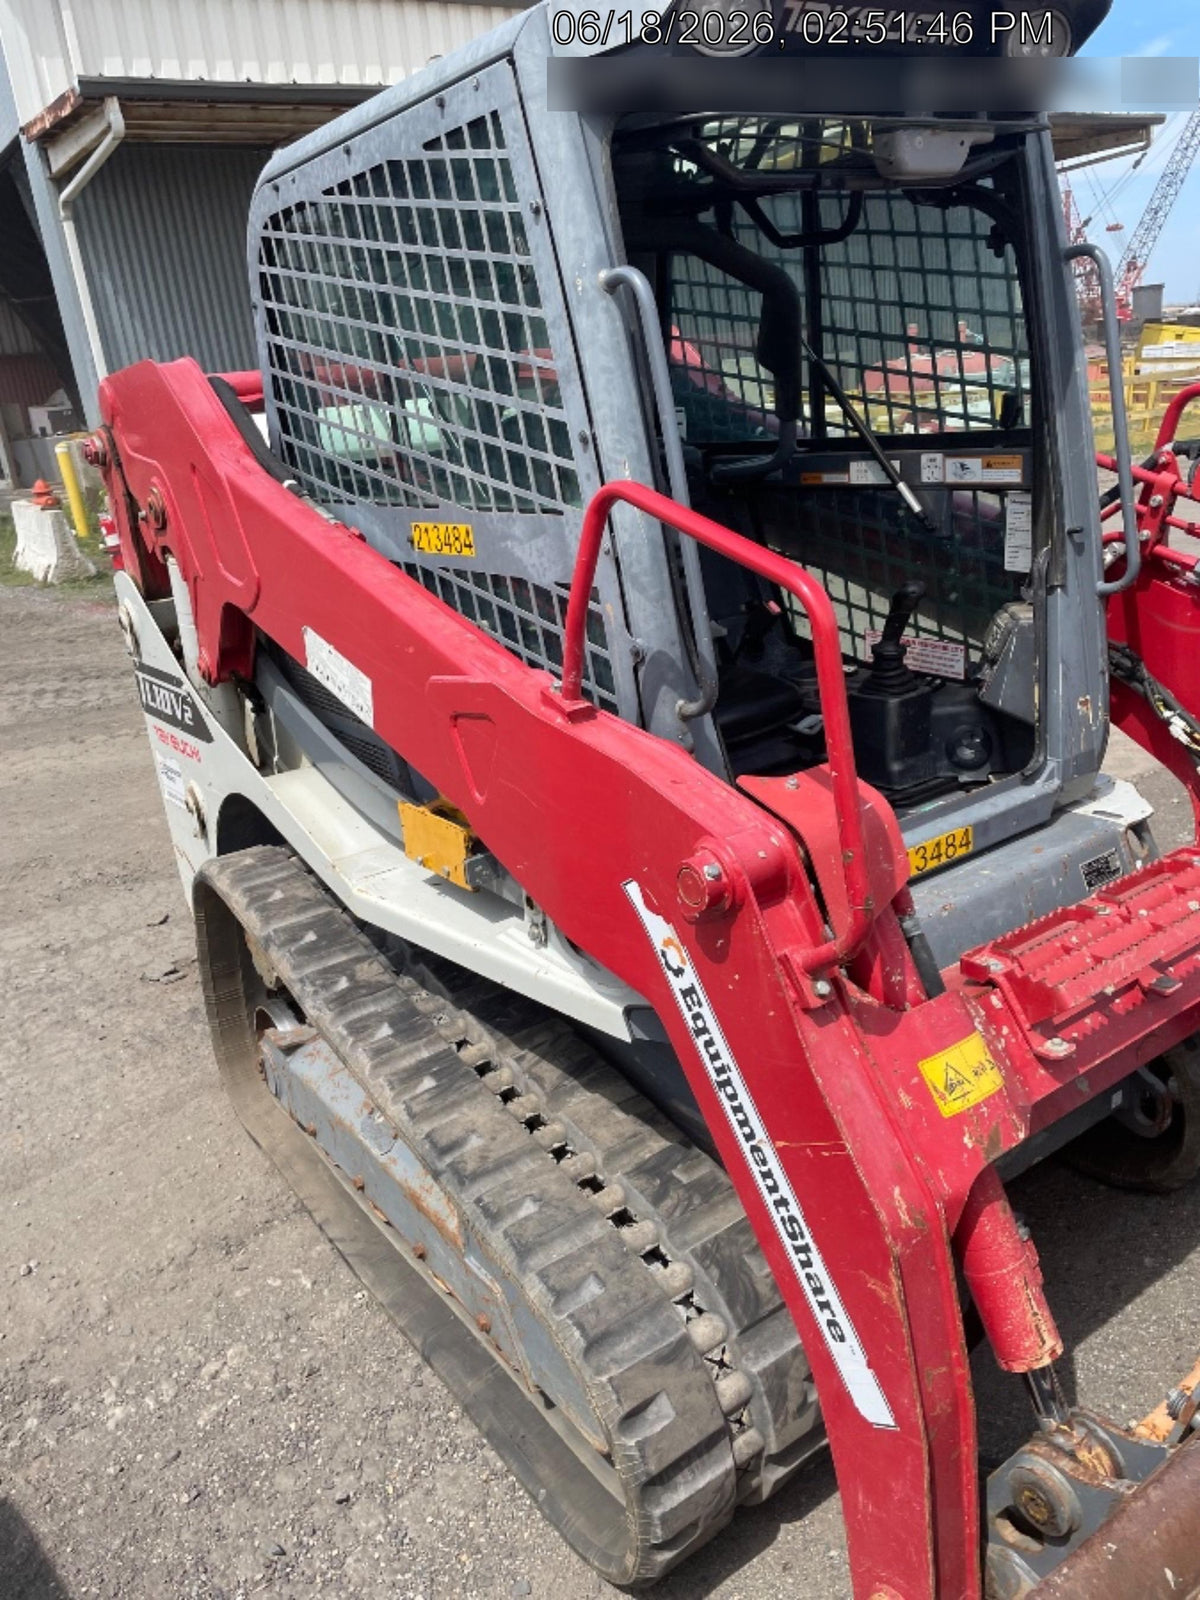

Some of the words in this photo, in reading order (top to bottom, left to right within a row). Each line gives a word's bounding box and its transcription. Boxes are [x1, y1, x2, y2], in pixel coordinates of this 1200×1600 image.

[413, 524, 474, 555] 213484
[907, 826, 972, 872] 3484
[669, 983, 846, 1343] EquipmentShare
